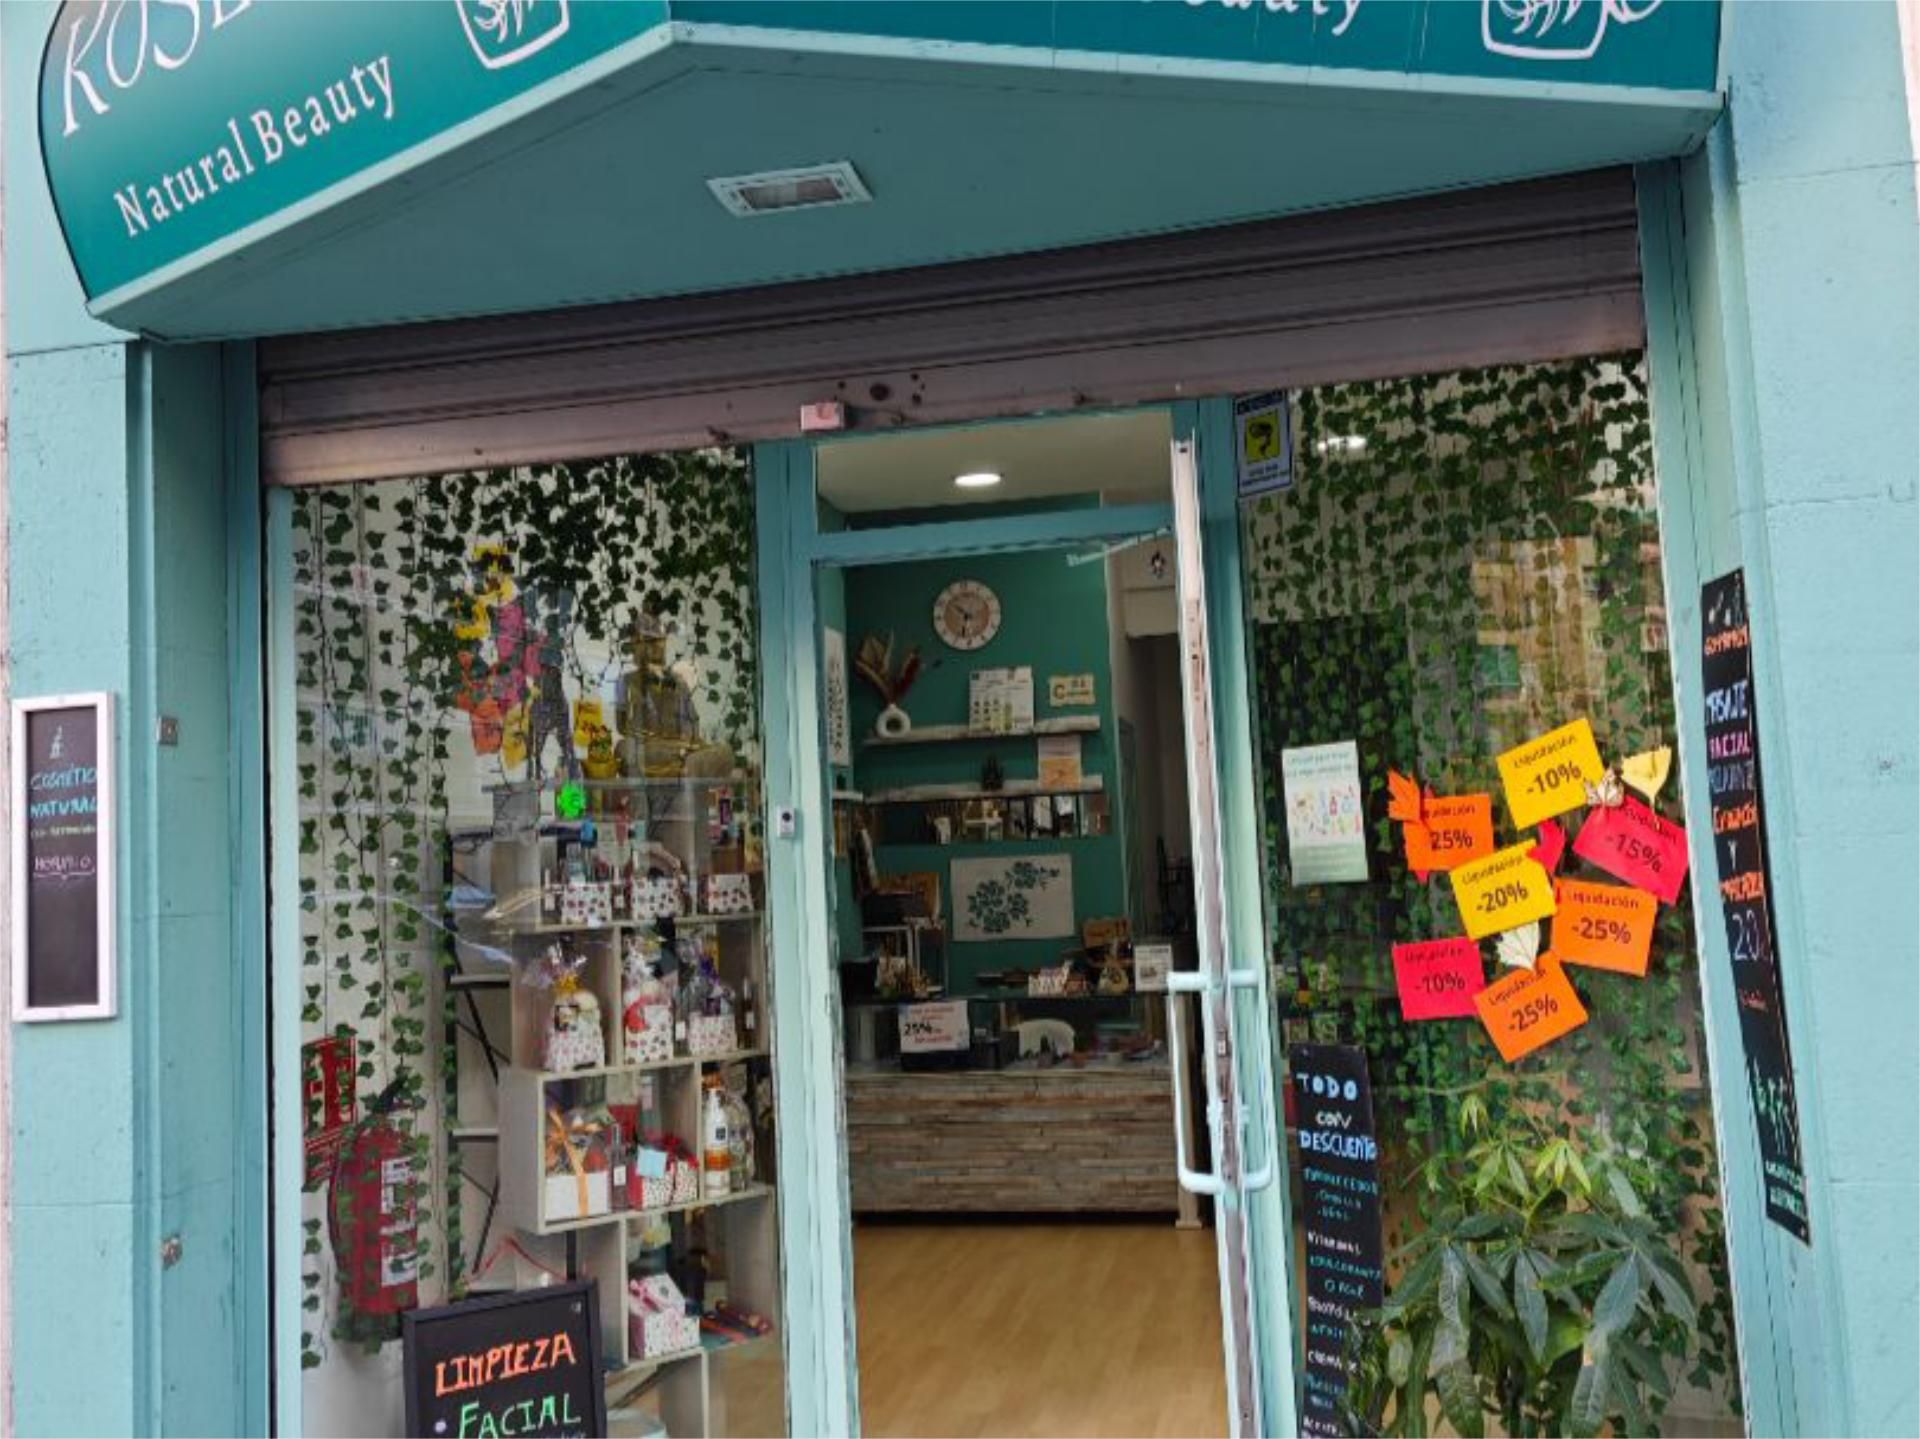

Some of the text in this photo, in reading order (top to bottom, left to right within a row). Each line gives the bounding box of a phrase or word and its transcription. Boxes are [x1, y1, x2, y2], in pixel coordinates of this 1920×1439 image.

[113, 54, 395, 238] Natural Beauty
[1526, 760, 1582, 795] -10%
[1604, 833, 1662, 874] -15%
[1476, 880, 1529, 913] -20%
[1571, 916, 1632, 945] -25%
[1414, 971, 1466, 994] -10%
[1508, 992, 1559, 1032] -25%
[1296, 1072, 1358, 1101] TODO
[435, 1331, 577, 1397] LIMPIEZA
[457, 1392, 583, 1439] FACIAL
